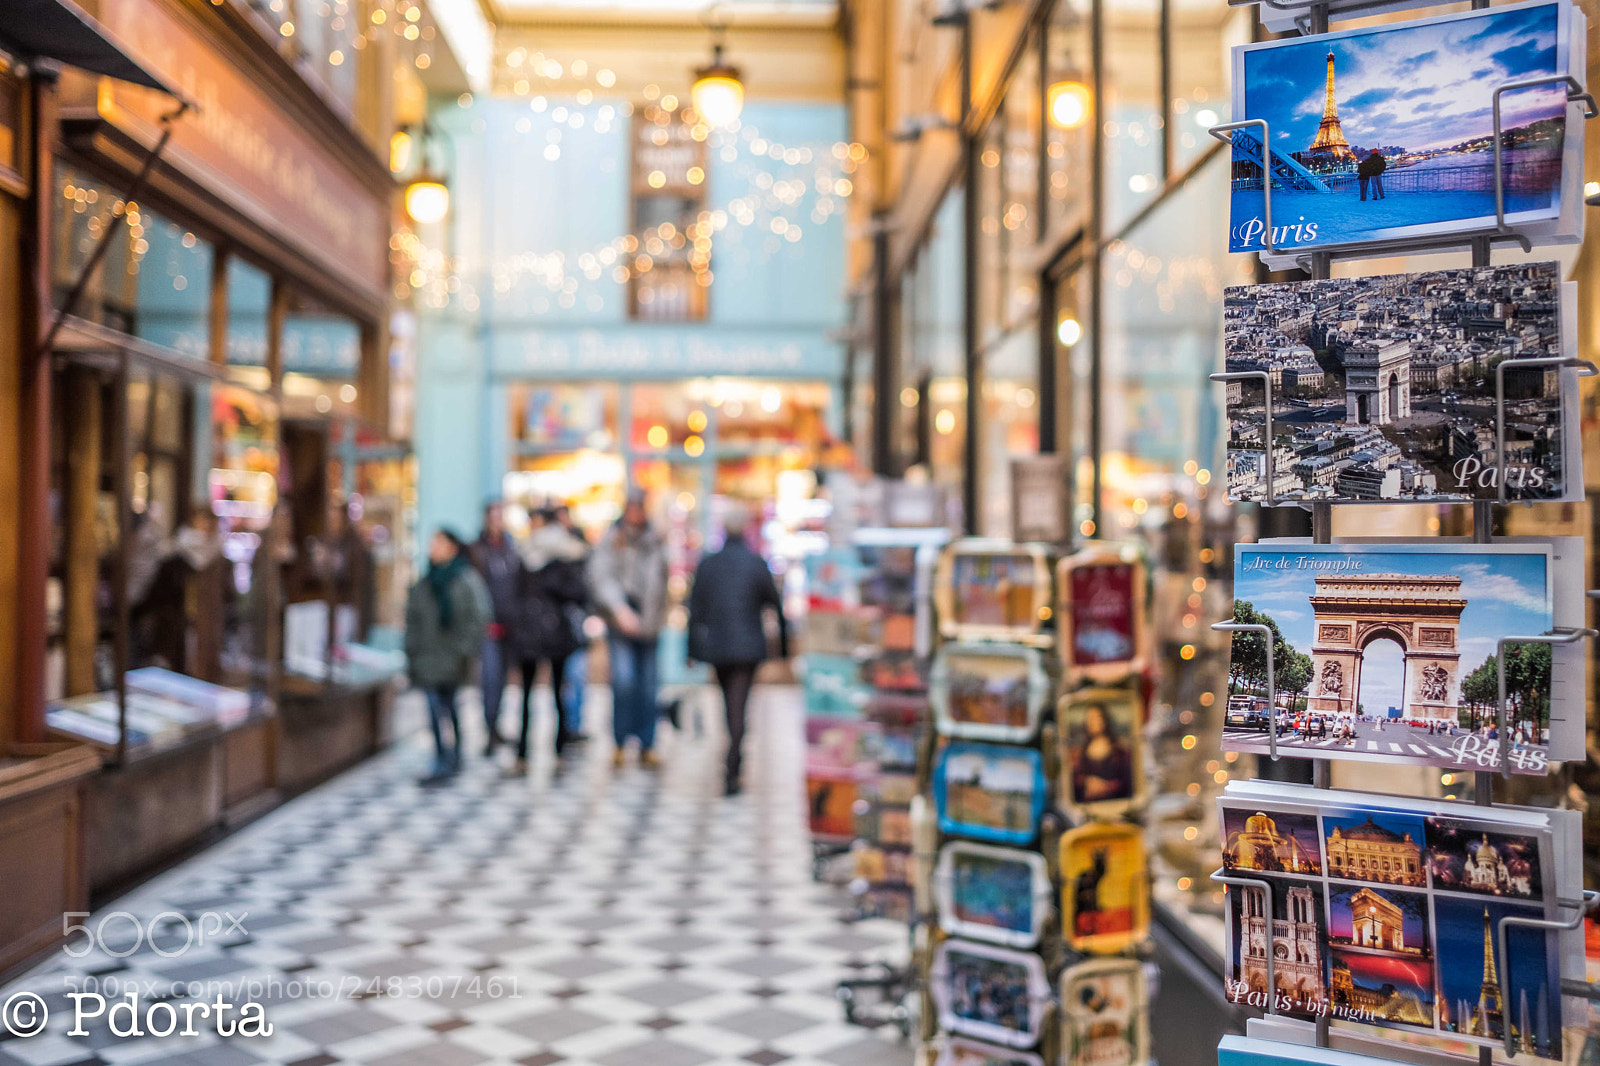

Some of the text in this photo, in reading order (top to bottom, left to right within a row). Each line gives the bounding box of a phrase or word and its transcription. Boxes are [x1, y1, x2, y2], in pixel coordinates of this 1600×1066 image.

[1239, 216, 1318, 247] Paris
[1453, 454, 1545, 488] Paris
[1244, 556, 1363, 573] Arc de Triomphe
[1306, 997, 1329, 1017] by
[1332, 1002, 1376, 1023] night
